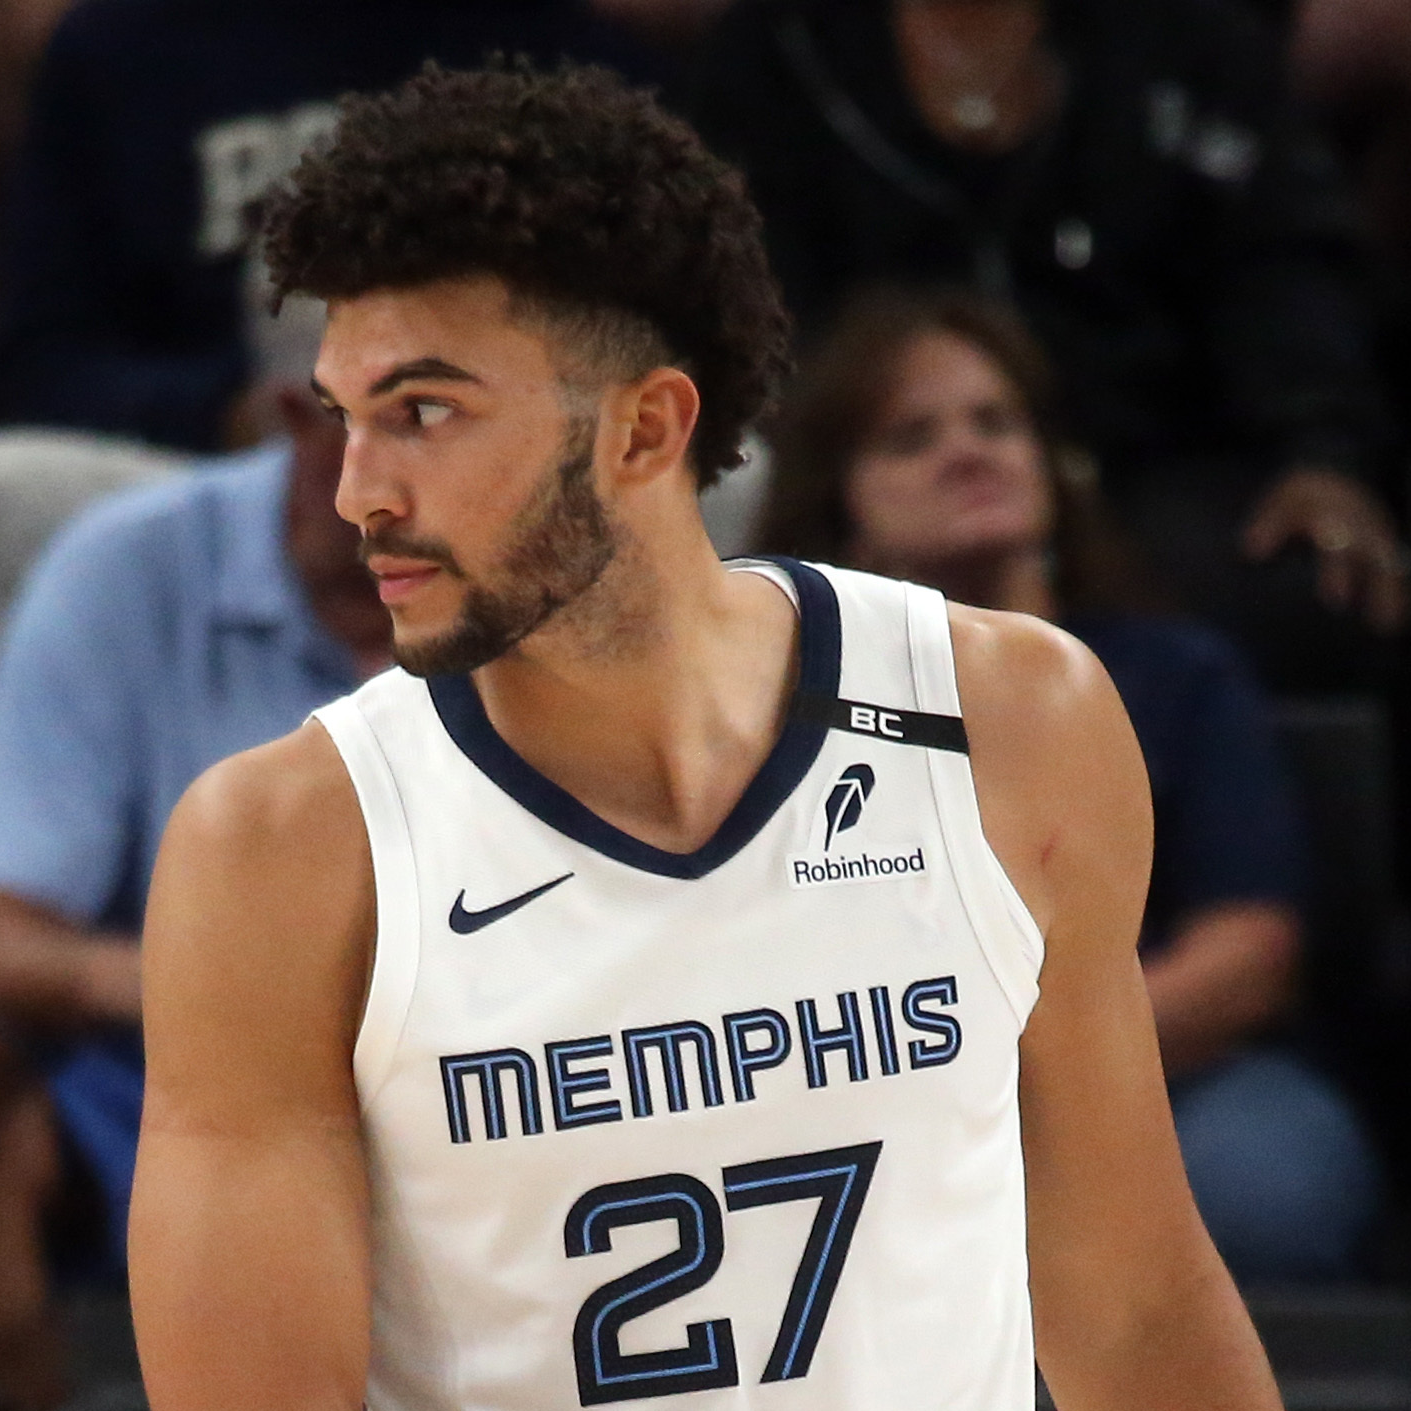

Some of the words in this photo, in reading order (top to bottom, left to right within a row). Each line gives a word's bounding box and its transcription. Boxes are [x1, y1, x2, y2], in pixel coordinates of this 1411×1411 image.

[850, 705, 904, 738] BC
[793, 847, 925, 884] Robinhood
[439, 975, 962, 1144] MEMPHIS
[564, 1140, 883, 1407] 27
